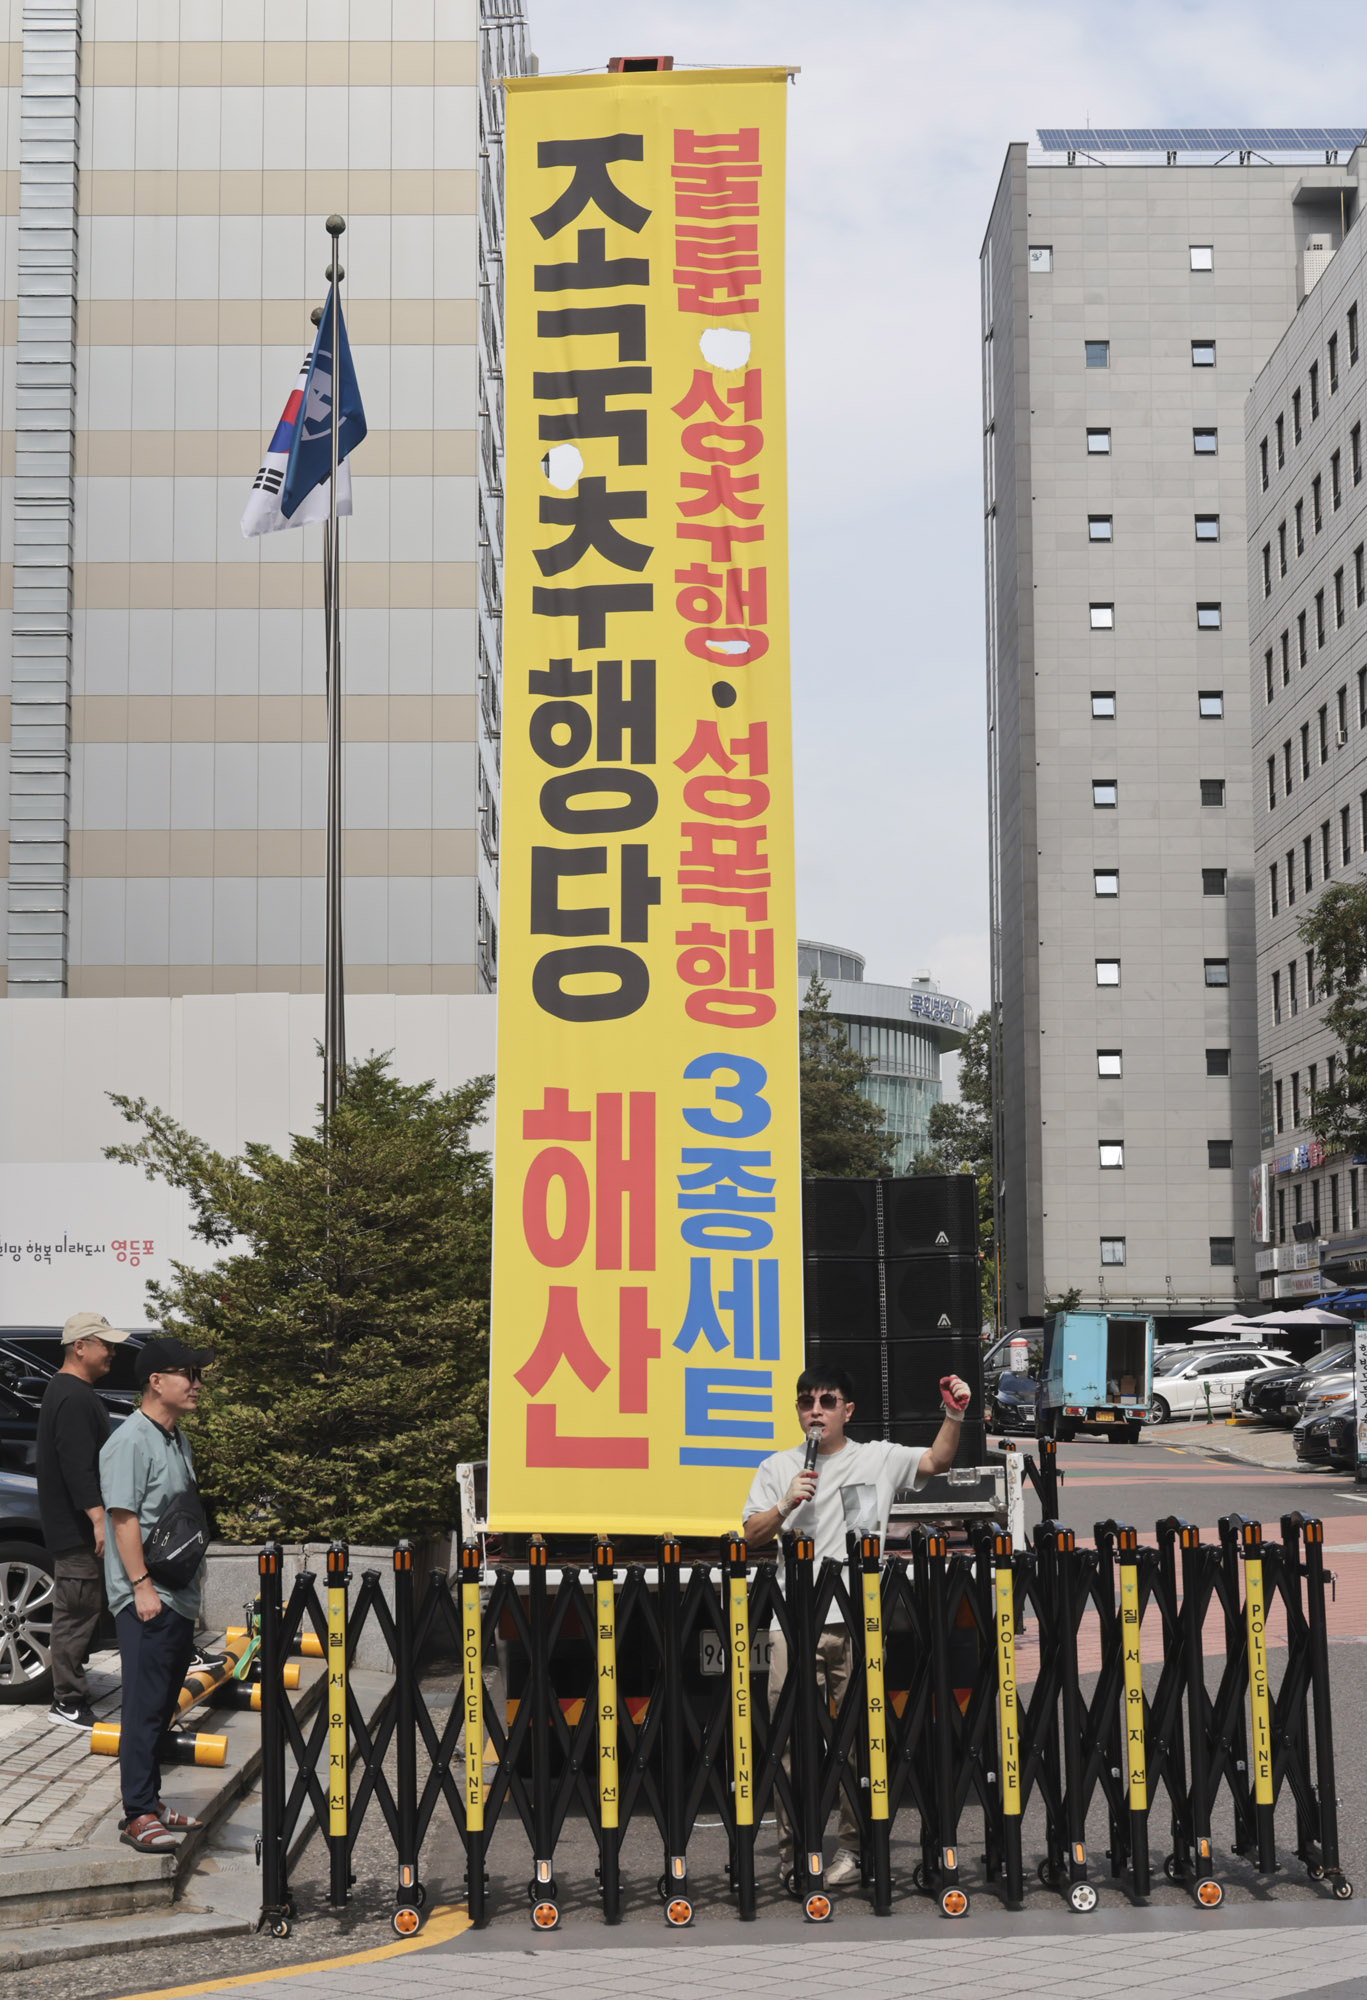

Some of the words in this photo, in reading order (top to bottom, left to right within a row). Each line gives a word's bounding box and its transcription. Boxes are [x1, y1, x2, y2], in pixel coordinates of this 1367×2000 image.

[672, 127, 763, 316] 불륜
[529, 133, 661, 1023] 조국추행당
[910, 994, 953, 1024] 국회방송
[26, 1239, 51, 1265] 행복
[55, 1231, 106, 1257] 미래도시
[111, 1240, 155, 1267] 영등포
[514, 1087, 661, 1468] 해산
[673, 1052, 780, 1468] 3종세트
[466, 1628, 478, 1723] POLICE
[735, 1623, 747, 1717] POLICE
[1000, 1614, 1013, 1708] POLICE
[1123, 1609, 1145, 1785] 질서유지선
[1252, 1604, 1265, 1697] POLICE
[329, 1632, 345, 1809] 질서유지선
[599, 1624, 616, 1802] 질서유지선
[866, 1617, 887, 1794] 질서유지선
[1258, 1716, 1269, 1778] LINE
[469, 1742, 479, 1805] LINE
[739, 1736, 749, 1799] LINE
[1006, 1727, 1017, 1788] LINE
